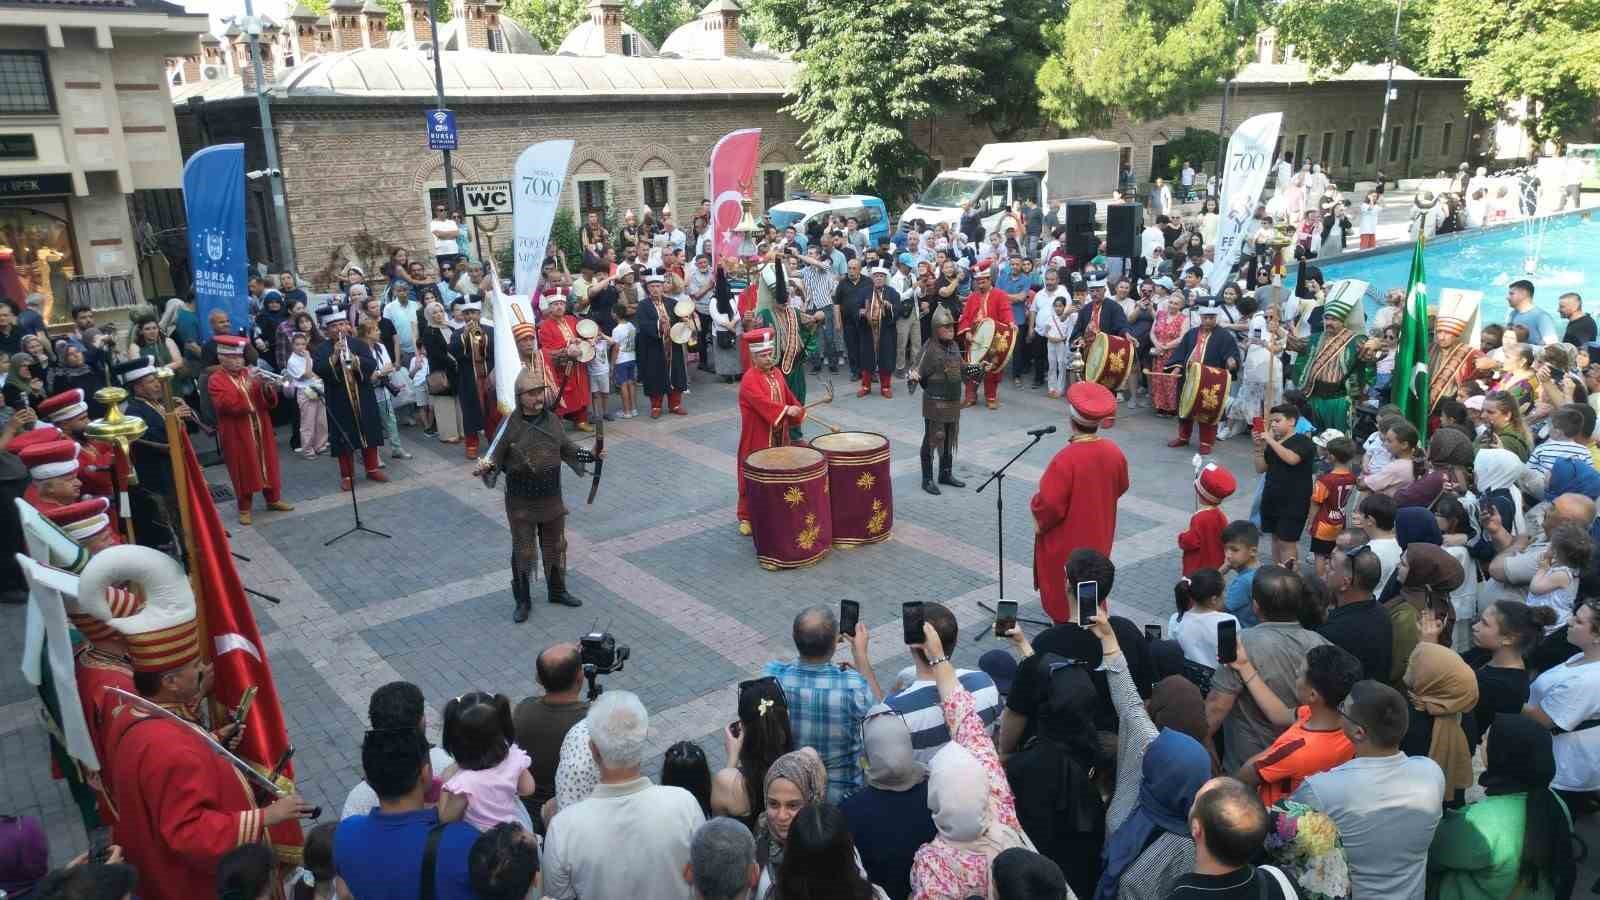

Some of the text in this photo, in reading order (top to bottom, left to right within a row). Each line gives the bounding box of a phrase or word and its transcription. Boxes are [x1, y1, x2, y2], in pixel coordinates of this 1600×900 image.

[1233, 152, 1265, 172] 700
[522, 176, 560, 198] 700
[468, 192, 508, 207] WC
[195, 269, 234, 283] BURSA
